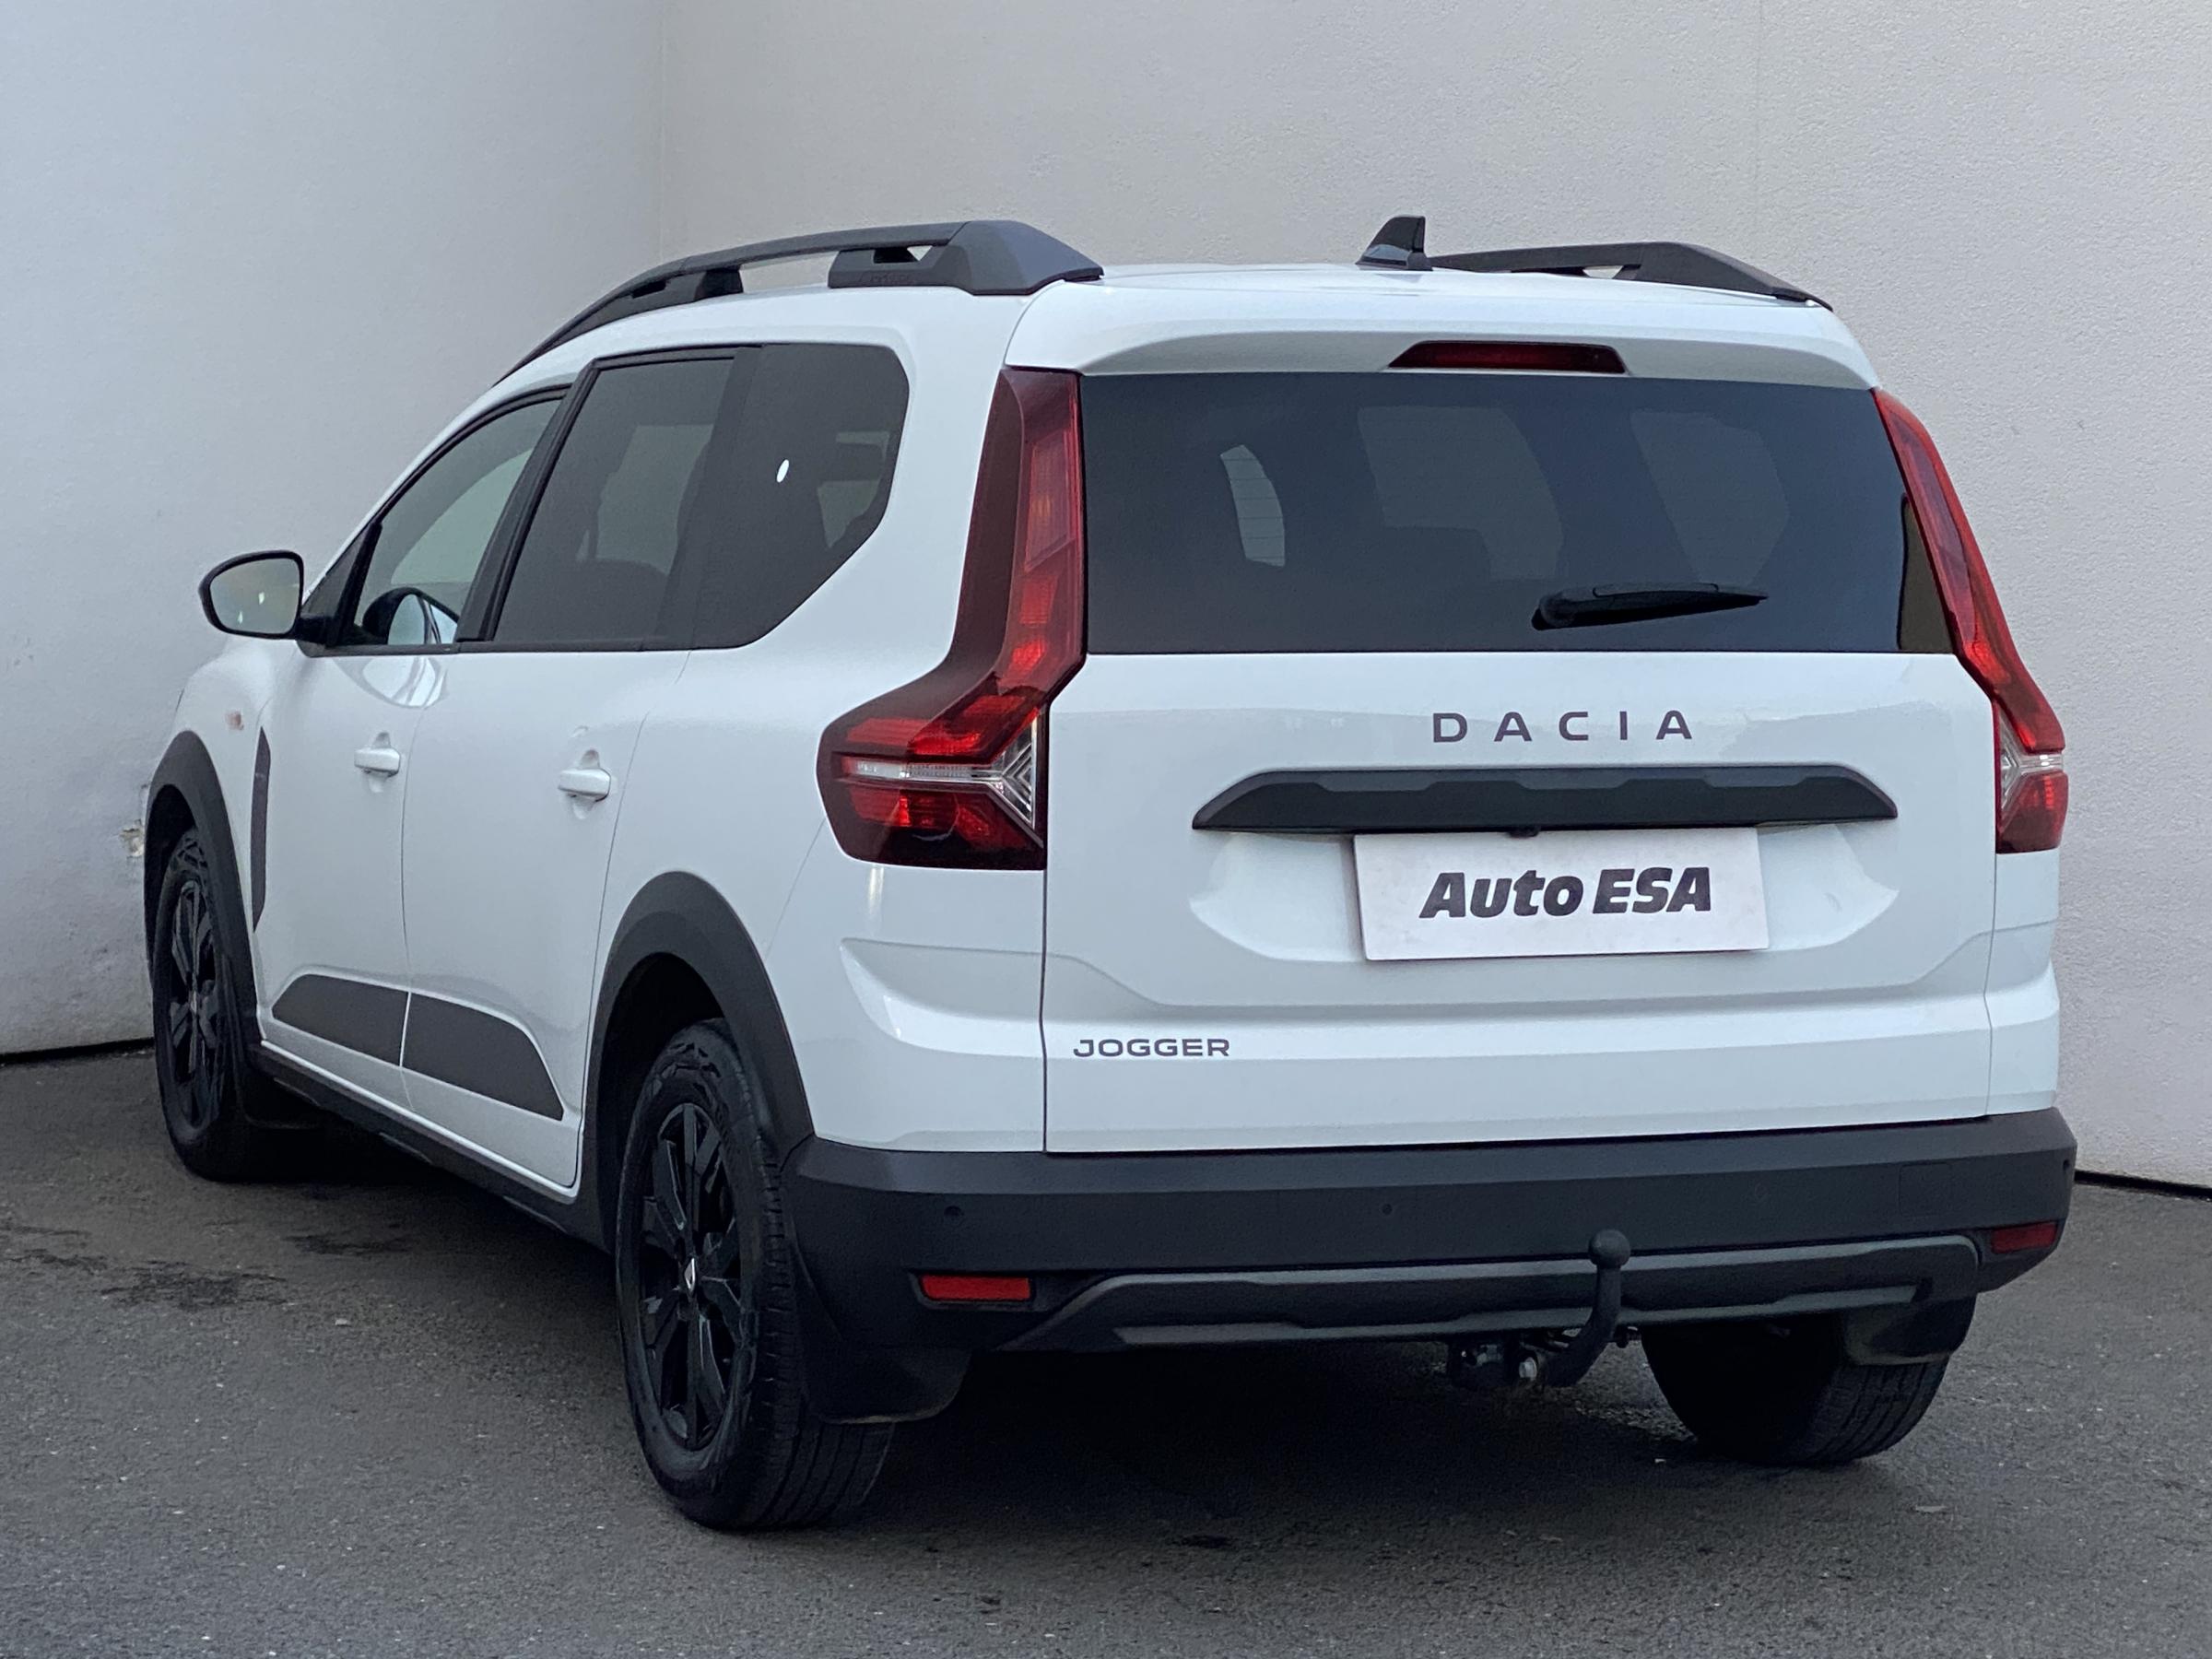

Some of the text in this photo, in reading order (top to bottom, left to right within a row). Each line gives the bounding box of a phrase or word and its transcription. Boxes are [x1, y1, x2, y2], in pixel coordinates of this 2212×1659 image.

[1433, 711, 1692, 743] DACIA
[1419, 866, 1712, 919] Auto ESA
[1073, 1039, 1230, 1057] JOGGER
